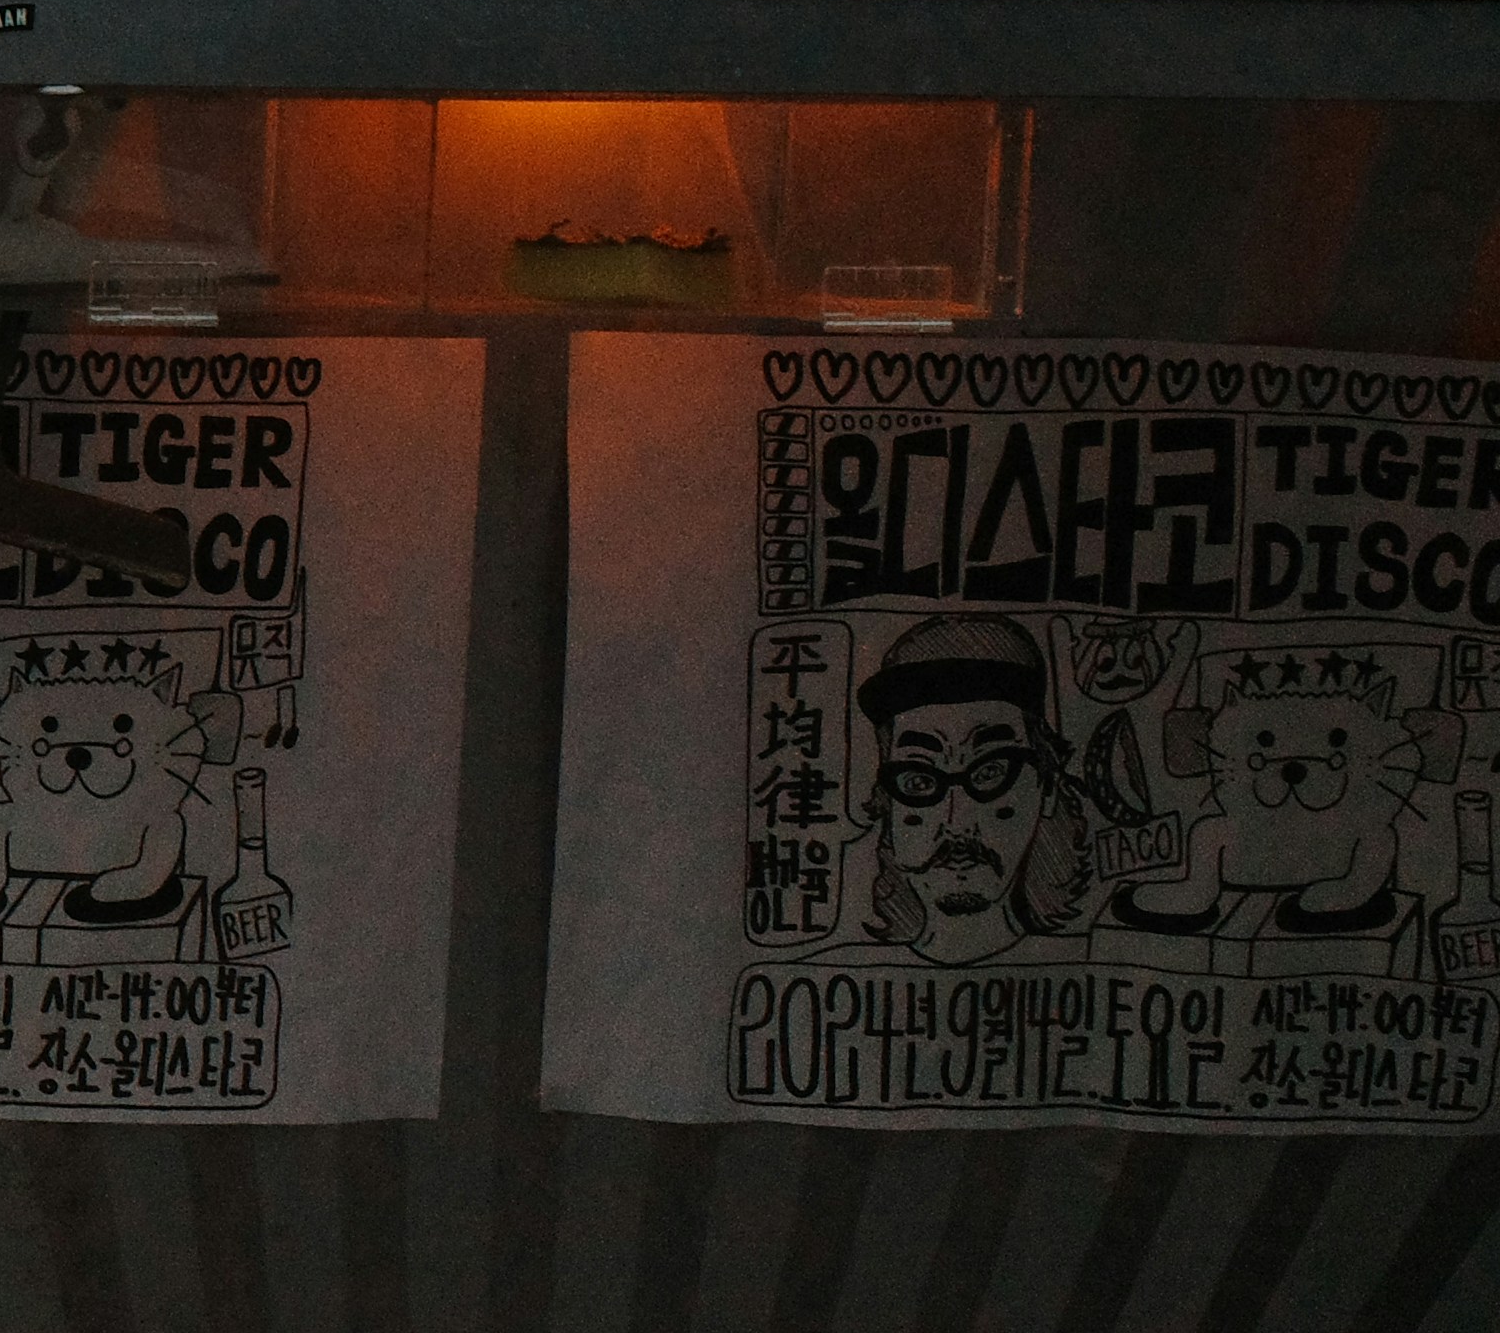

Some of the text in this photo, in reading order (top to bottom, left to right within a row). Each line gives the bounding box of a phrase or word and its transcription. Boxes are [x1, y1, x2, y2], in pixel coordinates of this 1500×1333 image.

[41, 413, 295, 490] TIGER
[236, 618, 295, 683] 뮤직
[754, 632, 839, 829] 平均律
[1101, 830, 1175, 871] TACO
[221, 901, 290, 953] BEER
